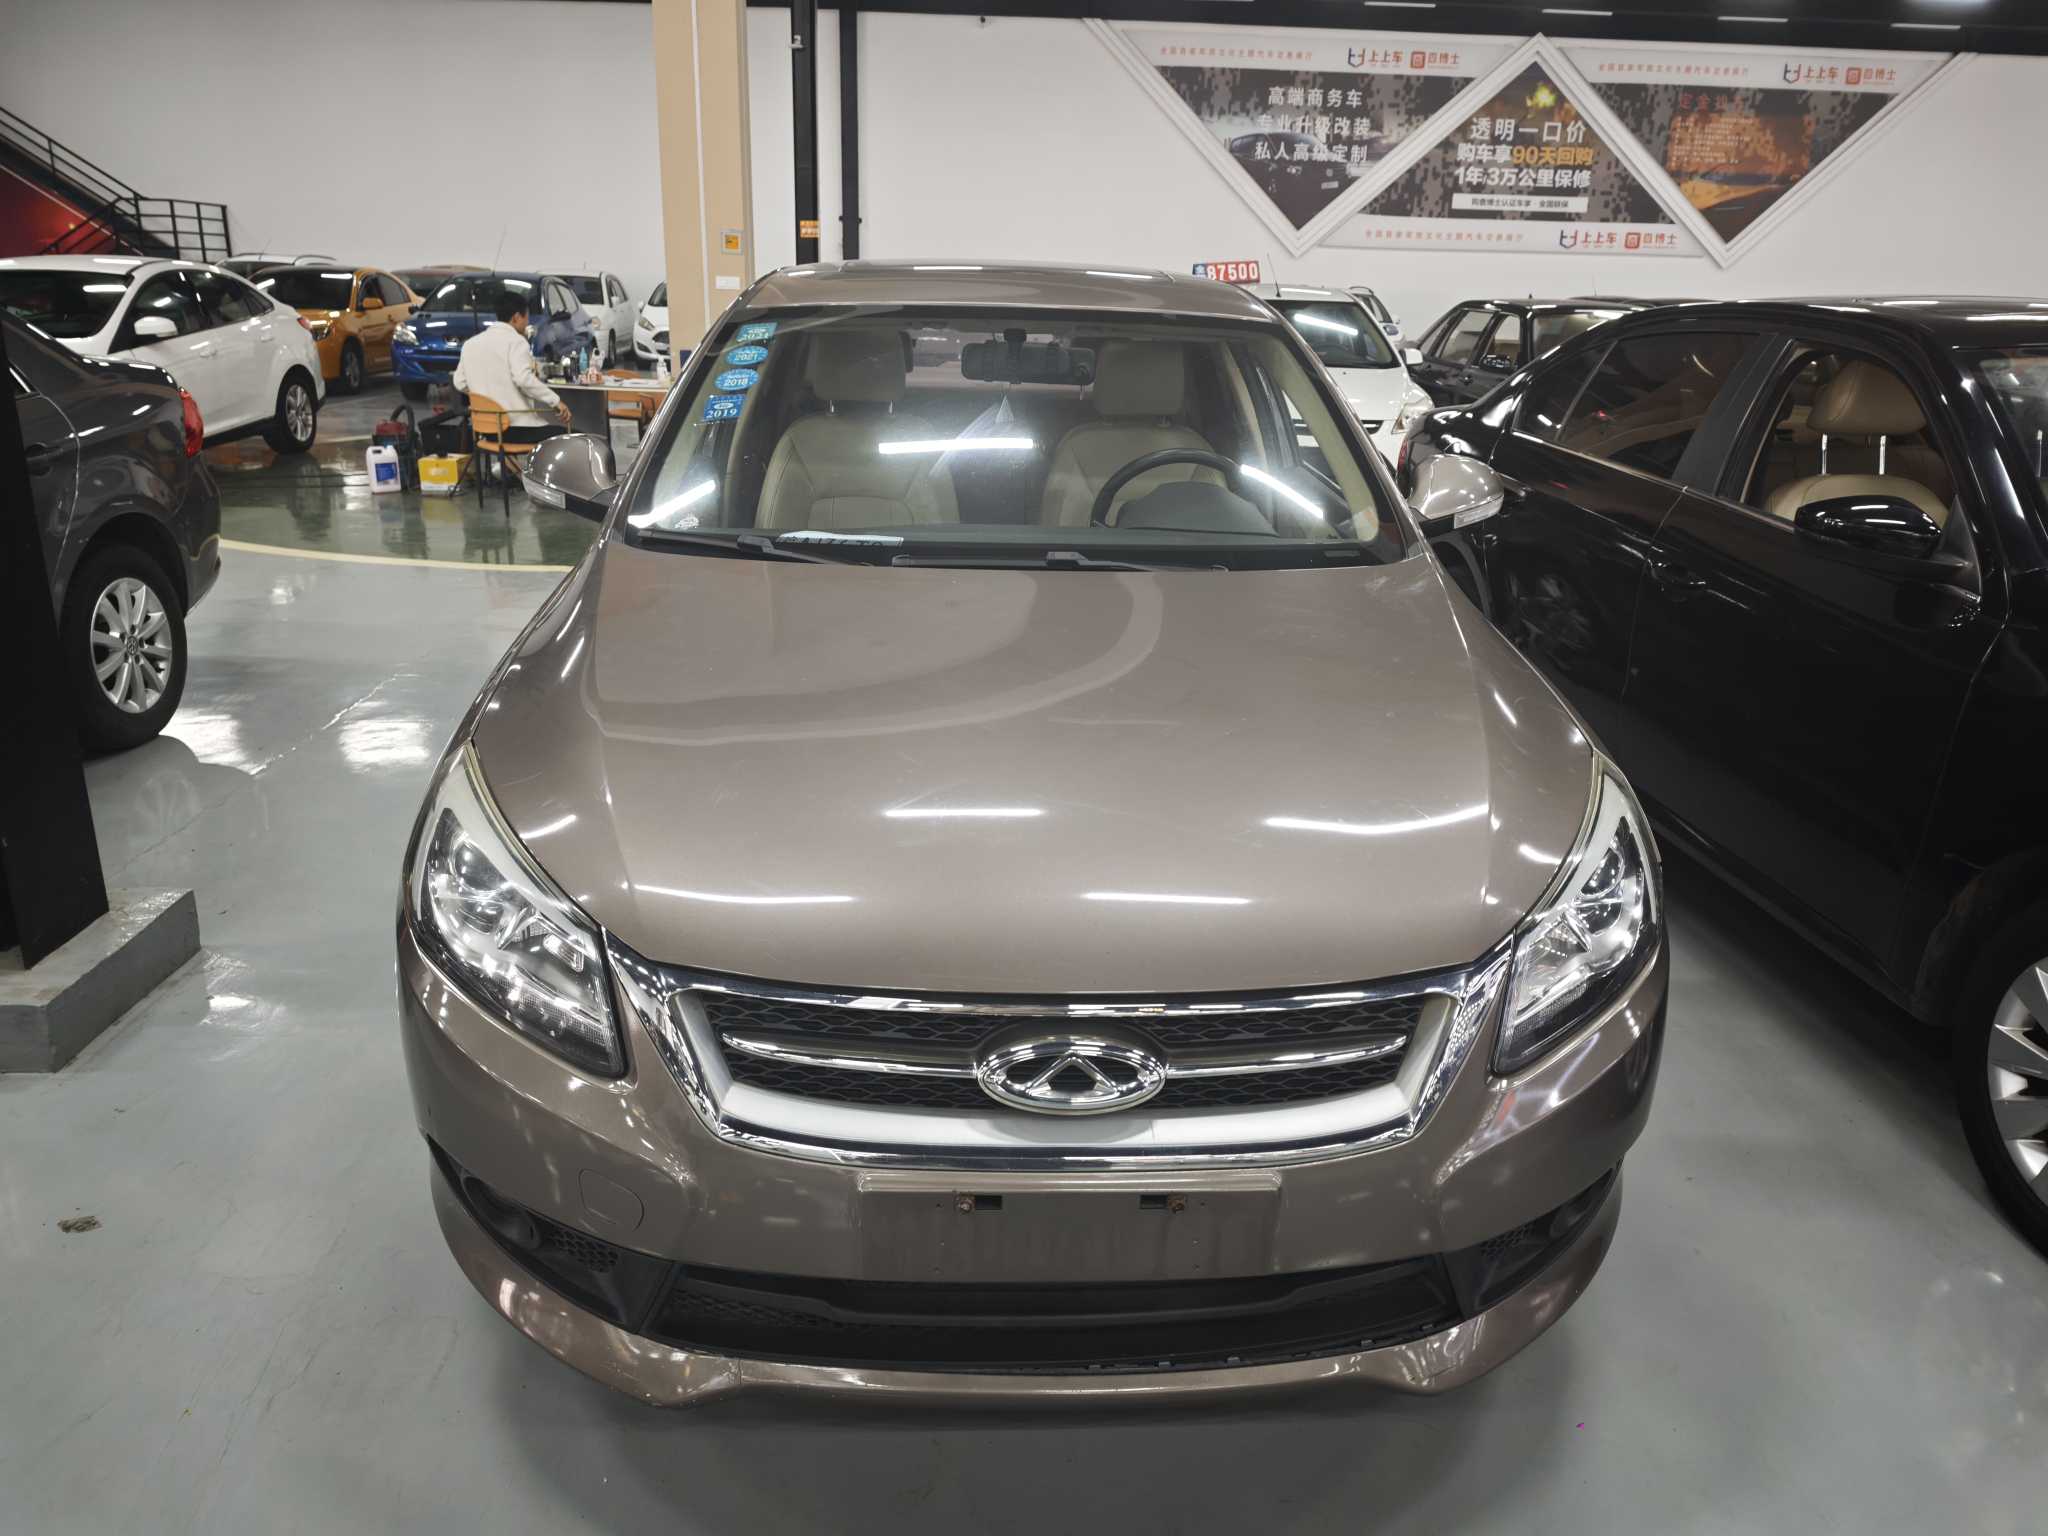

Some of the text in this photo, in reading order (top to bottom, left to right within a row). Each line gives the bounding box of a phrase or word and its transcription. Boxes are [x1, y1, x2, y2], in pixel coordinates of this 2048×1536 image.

[1368, 49, 1403, 63] 上上车
[1803, 66, 1839, 80] 上上车
[1268, 86, 1362, 108] 高端商务车
[1257, 113, 1371, 139] 专业升级改装
[1470, 117, 1586, 143] 透明一口价
[1255, 141, 1367, 165] 私人高级定制
[1457, 143, 1593, 165] 购车享90天回购
[1582, 231, 1616, 244] 上上车
[1206, 263, 1258, 280] 87500
[724, 377, 749, 386] 2018
[706, 408, 737, 418] 2019
